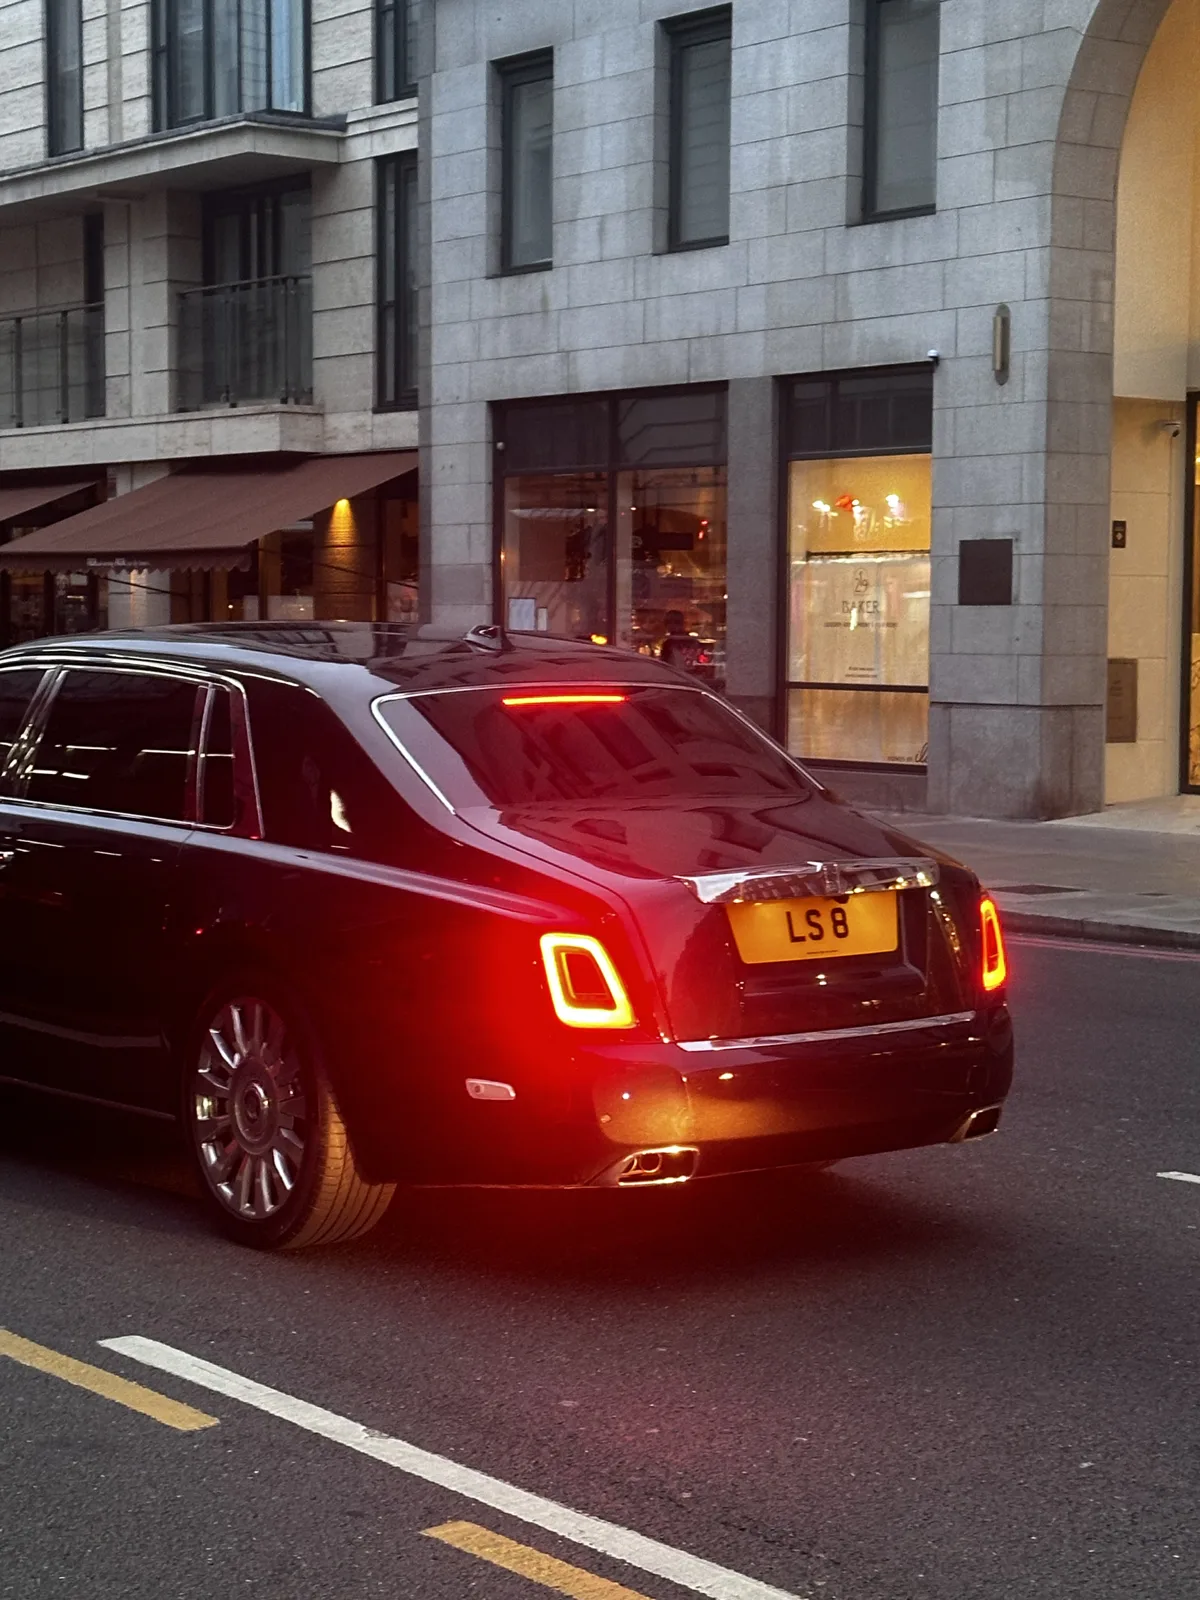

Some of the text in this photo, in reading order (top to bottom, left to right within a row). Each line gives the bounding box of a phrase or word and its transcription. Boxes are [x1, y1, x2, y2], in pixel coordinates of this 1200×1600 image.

[841, 600, 881, 614] BAKER
[785, 907, 850, 943] LS 8
